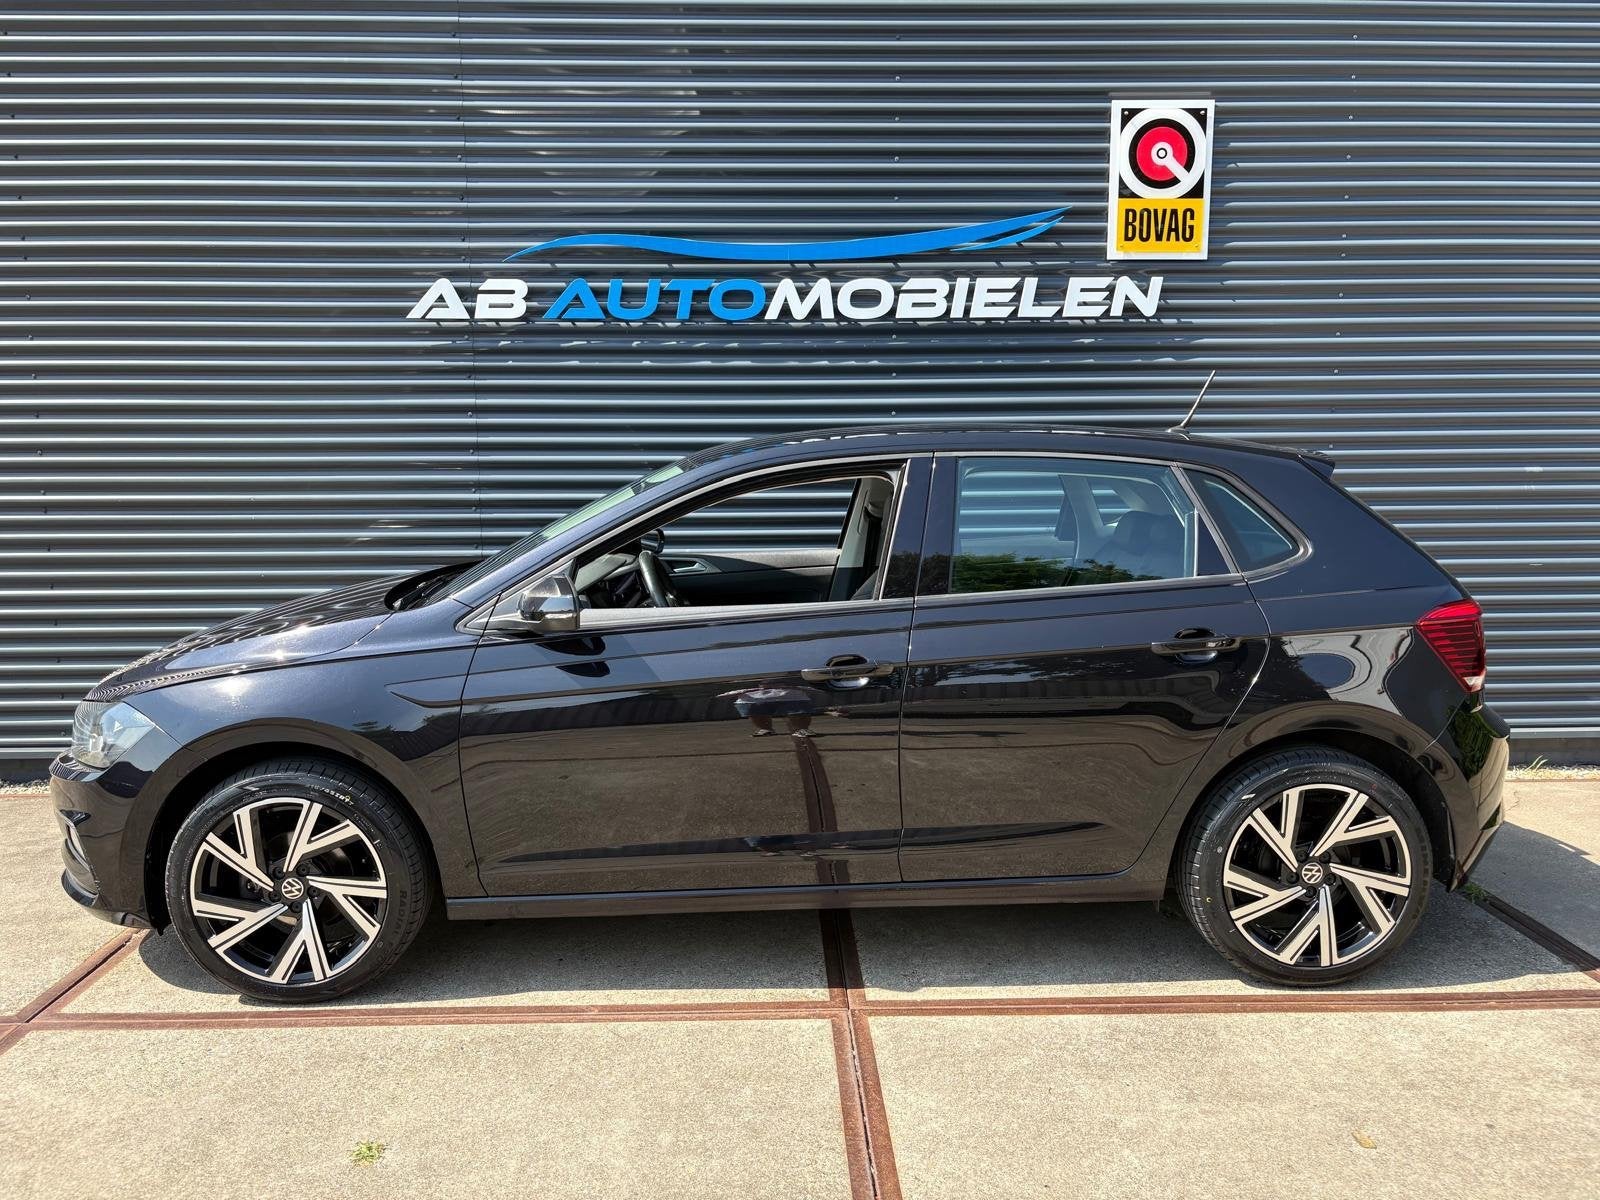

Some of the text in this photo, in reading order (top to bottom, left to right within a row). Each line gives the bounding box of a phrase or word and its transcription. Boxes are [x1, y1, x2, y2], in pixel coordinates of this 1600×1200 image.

[1123, 207, 1195, 243] BOVAG
[405, 275, 1164, 321] AB AUTOMOBIELEN
